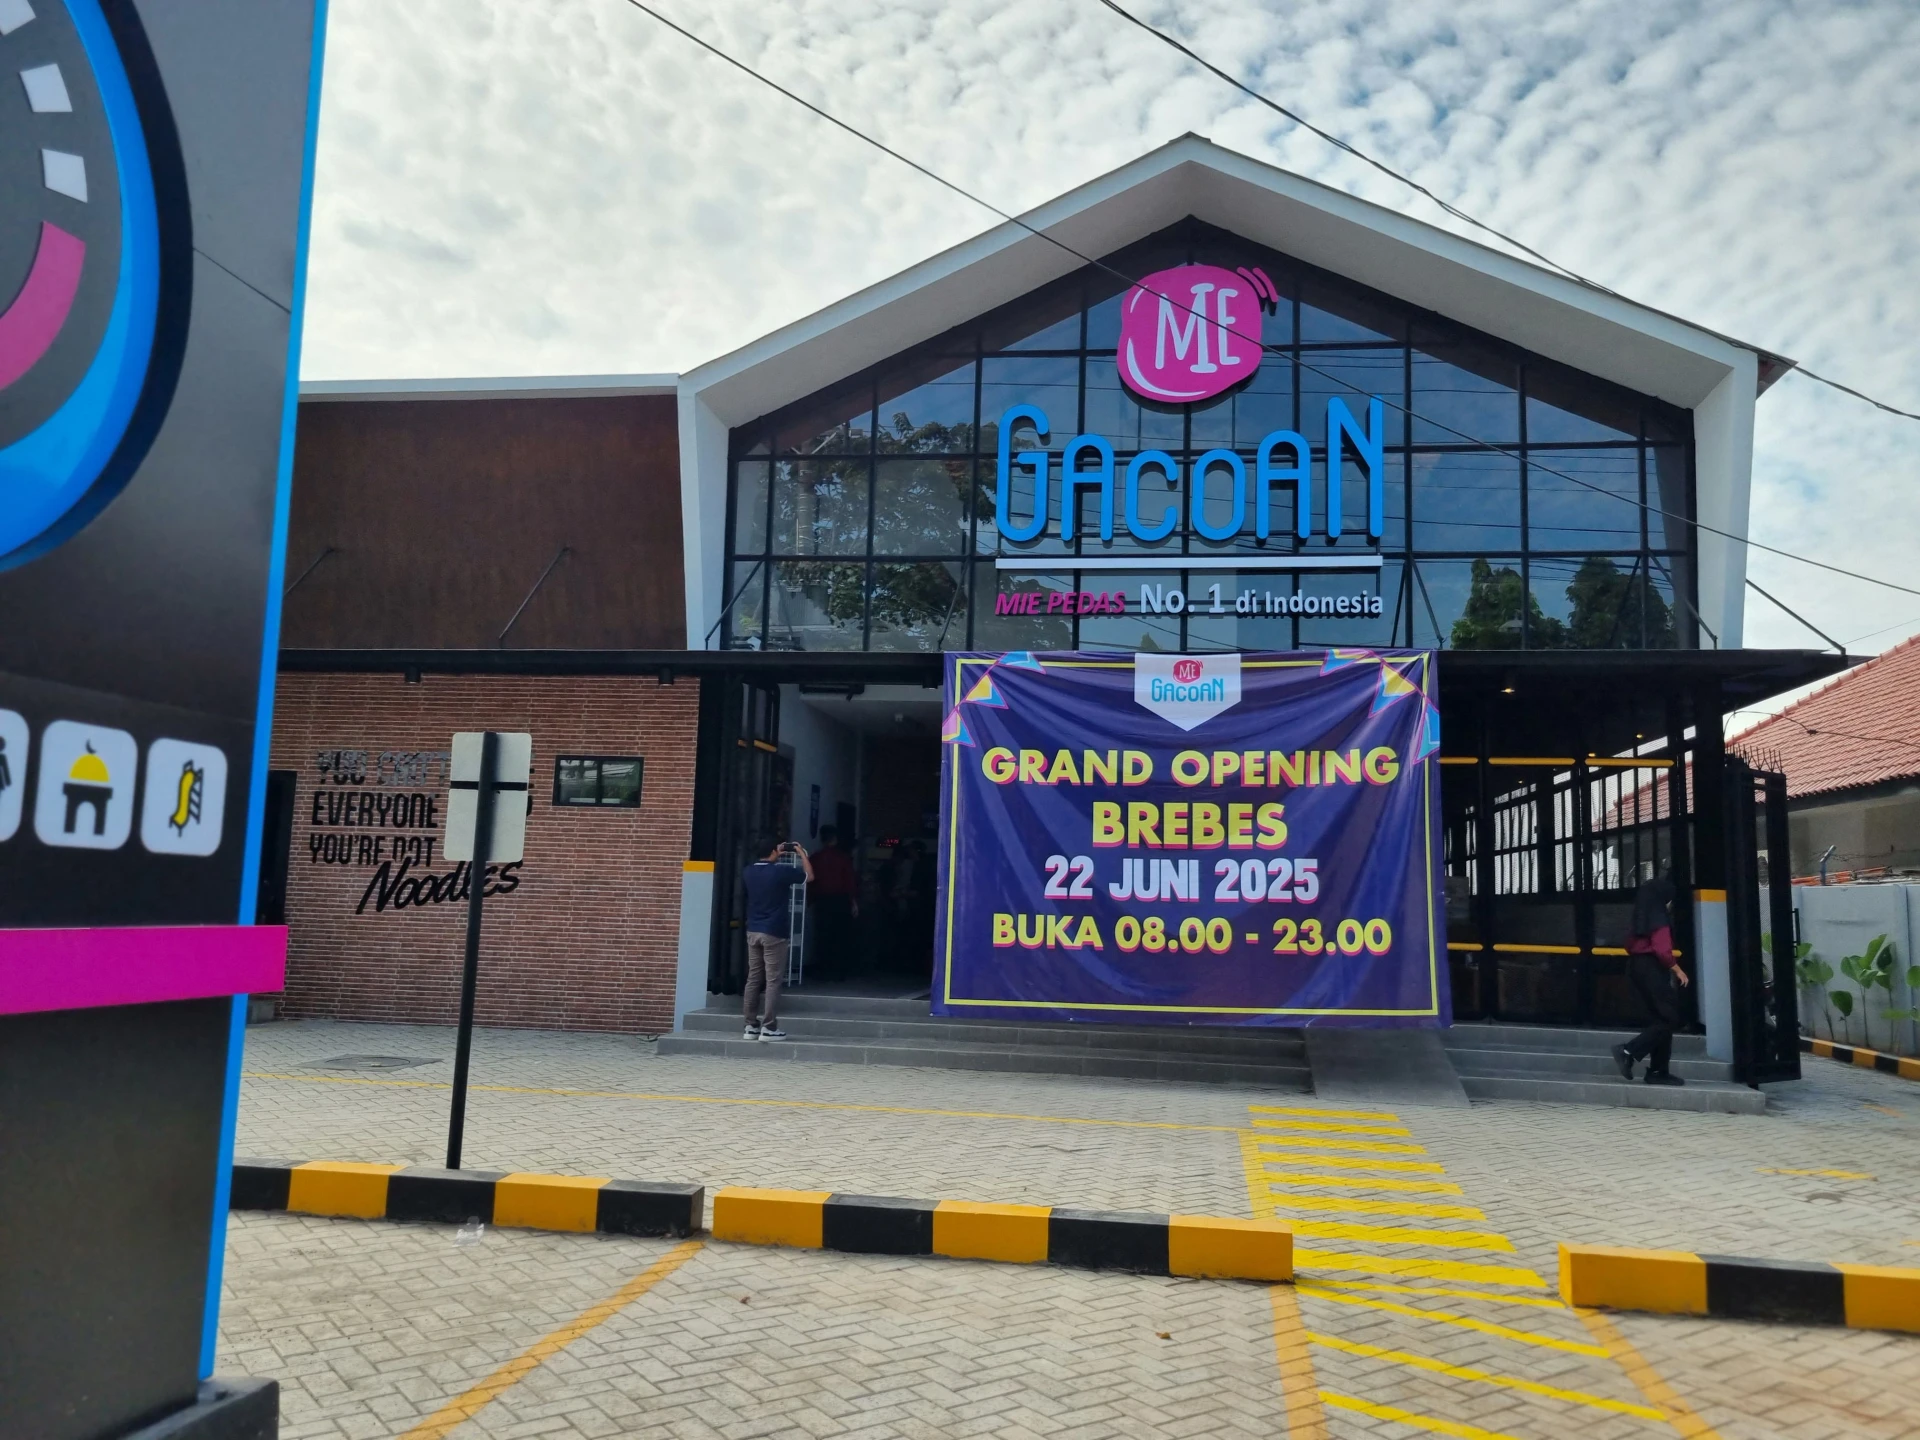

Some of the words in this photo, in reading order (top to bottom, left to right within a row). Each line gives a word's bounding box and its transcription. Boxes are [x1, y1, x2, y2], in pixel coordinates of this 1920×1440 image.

[996, 395, 1384, 542] GACOAN
[994, 592, 1042, 615] MIE
[1046, 591, 1126, 615] PEDAS
[1140, 583, 1195, 614] No.
[1208, 583, 1225, 614] 1
[1235, 590, 1256, 614] di
[1265, 590, 1384, 614] Indonesia
[1151, 678, 1224, 702] GACOAN
[981, 746, 1153, 786] GRAND
[1171, 746, 1399, 787] OPENING
[311, 791, 440, 828] EVERYONE
[1092, 801, 1288, 850] BREBES
[309, 833, 386, 866] YOU'RE
[392, 836, 437, 867] NOT
[1044, 854, 1094, 900] 22
[1109, 857, 1200, 901] JUNI
[1214, 857, 1319, 903] 2025
[992, 913, 1103, 950] BUKA
[1115, 916, 1232, 954] 08.00
[1245, 933, 1259, 947] -
[1272, 918, 1392, 956] 23.00
